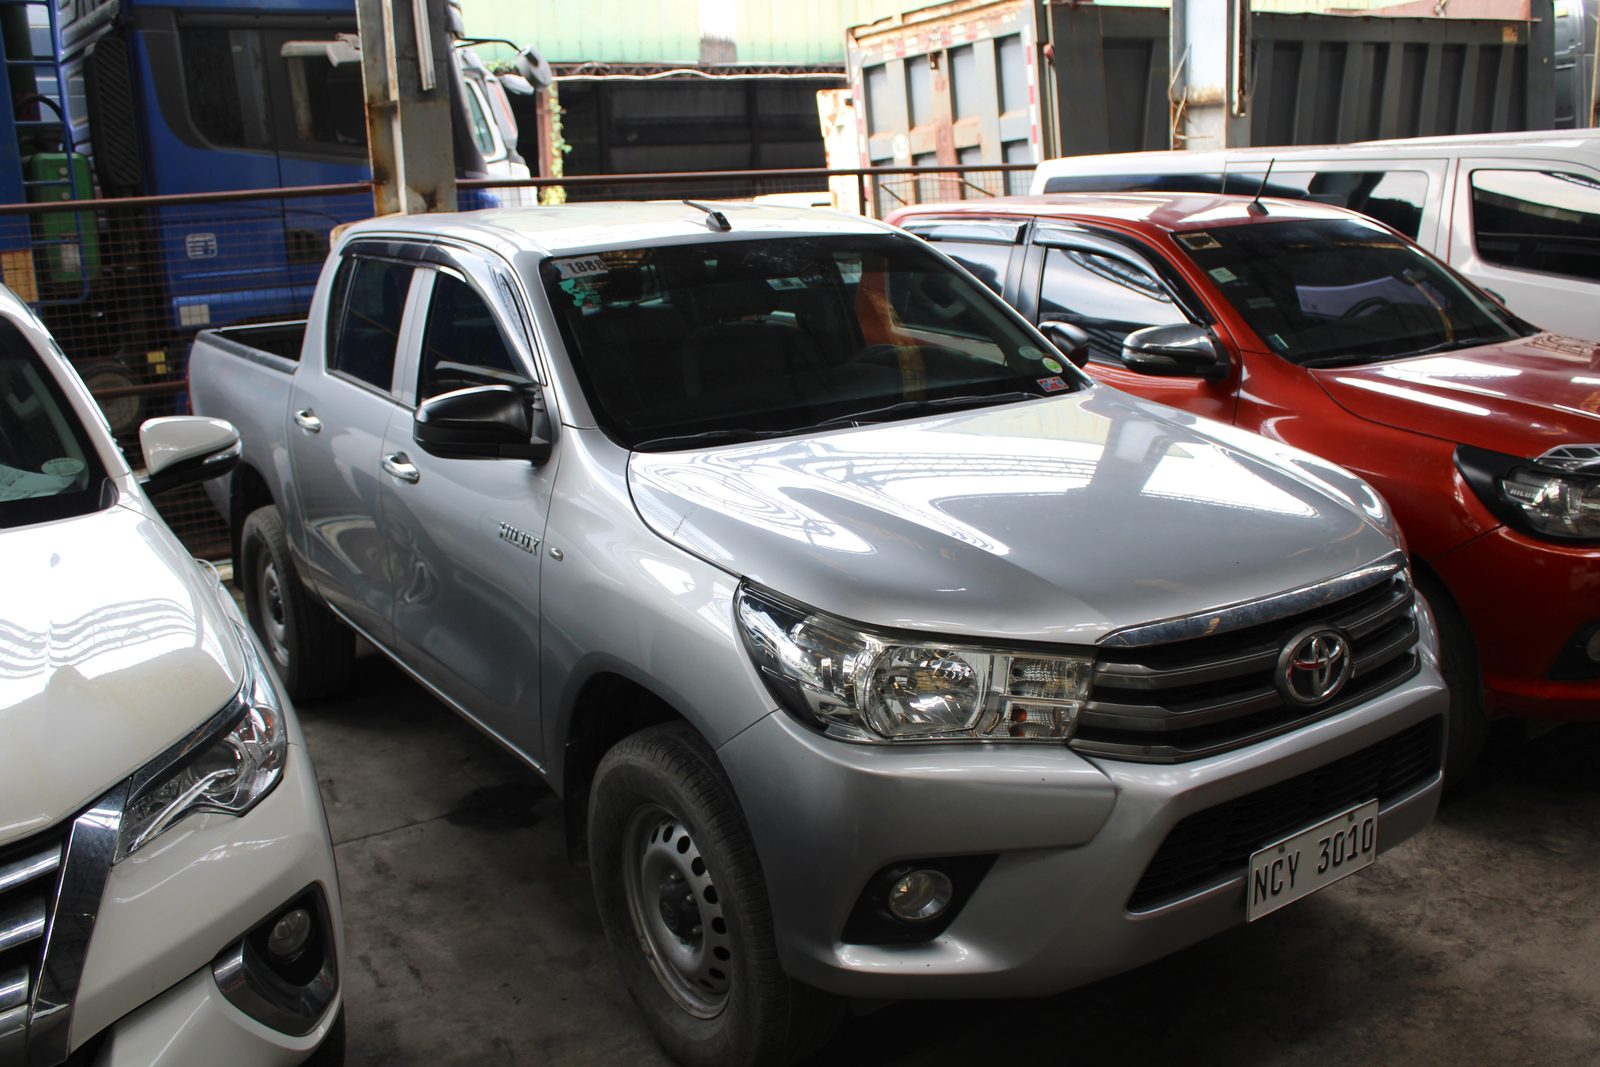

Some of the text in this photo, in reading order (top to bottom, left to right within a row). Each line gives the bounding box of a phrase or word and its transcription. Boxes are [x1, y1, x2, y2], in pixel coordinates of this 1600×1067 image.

[499, 521, 540, 557] HILUX
[1254, 818, 1374, 905] NCY 3010
